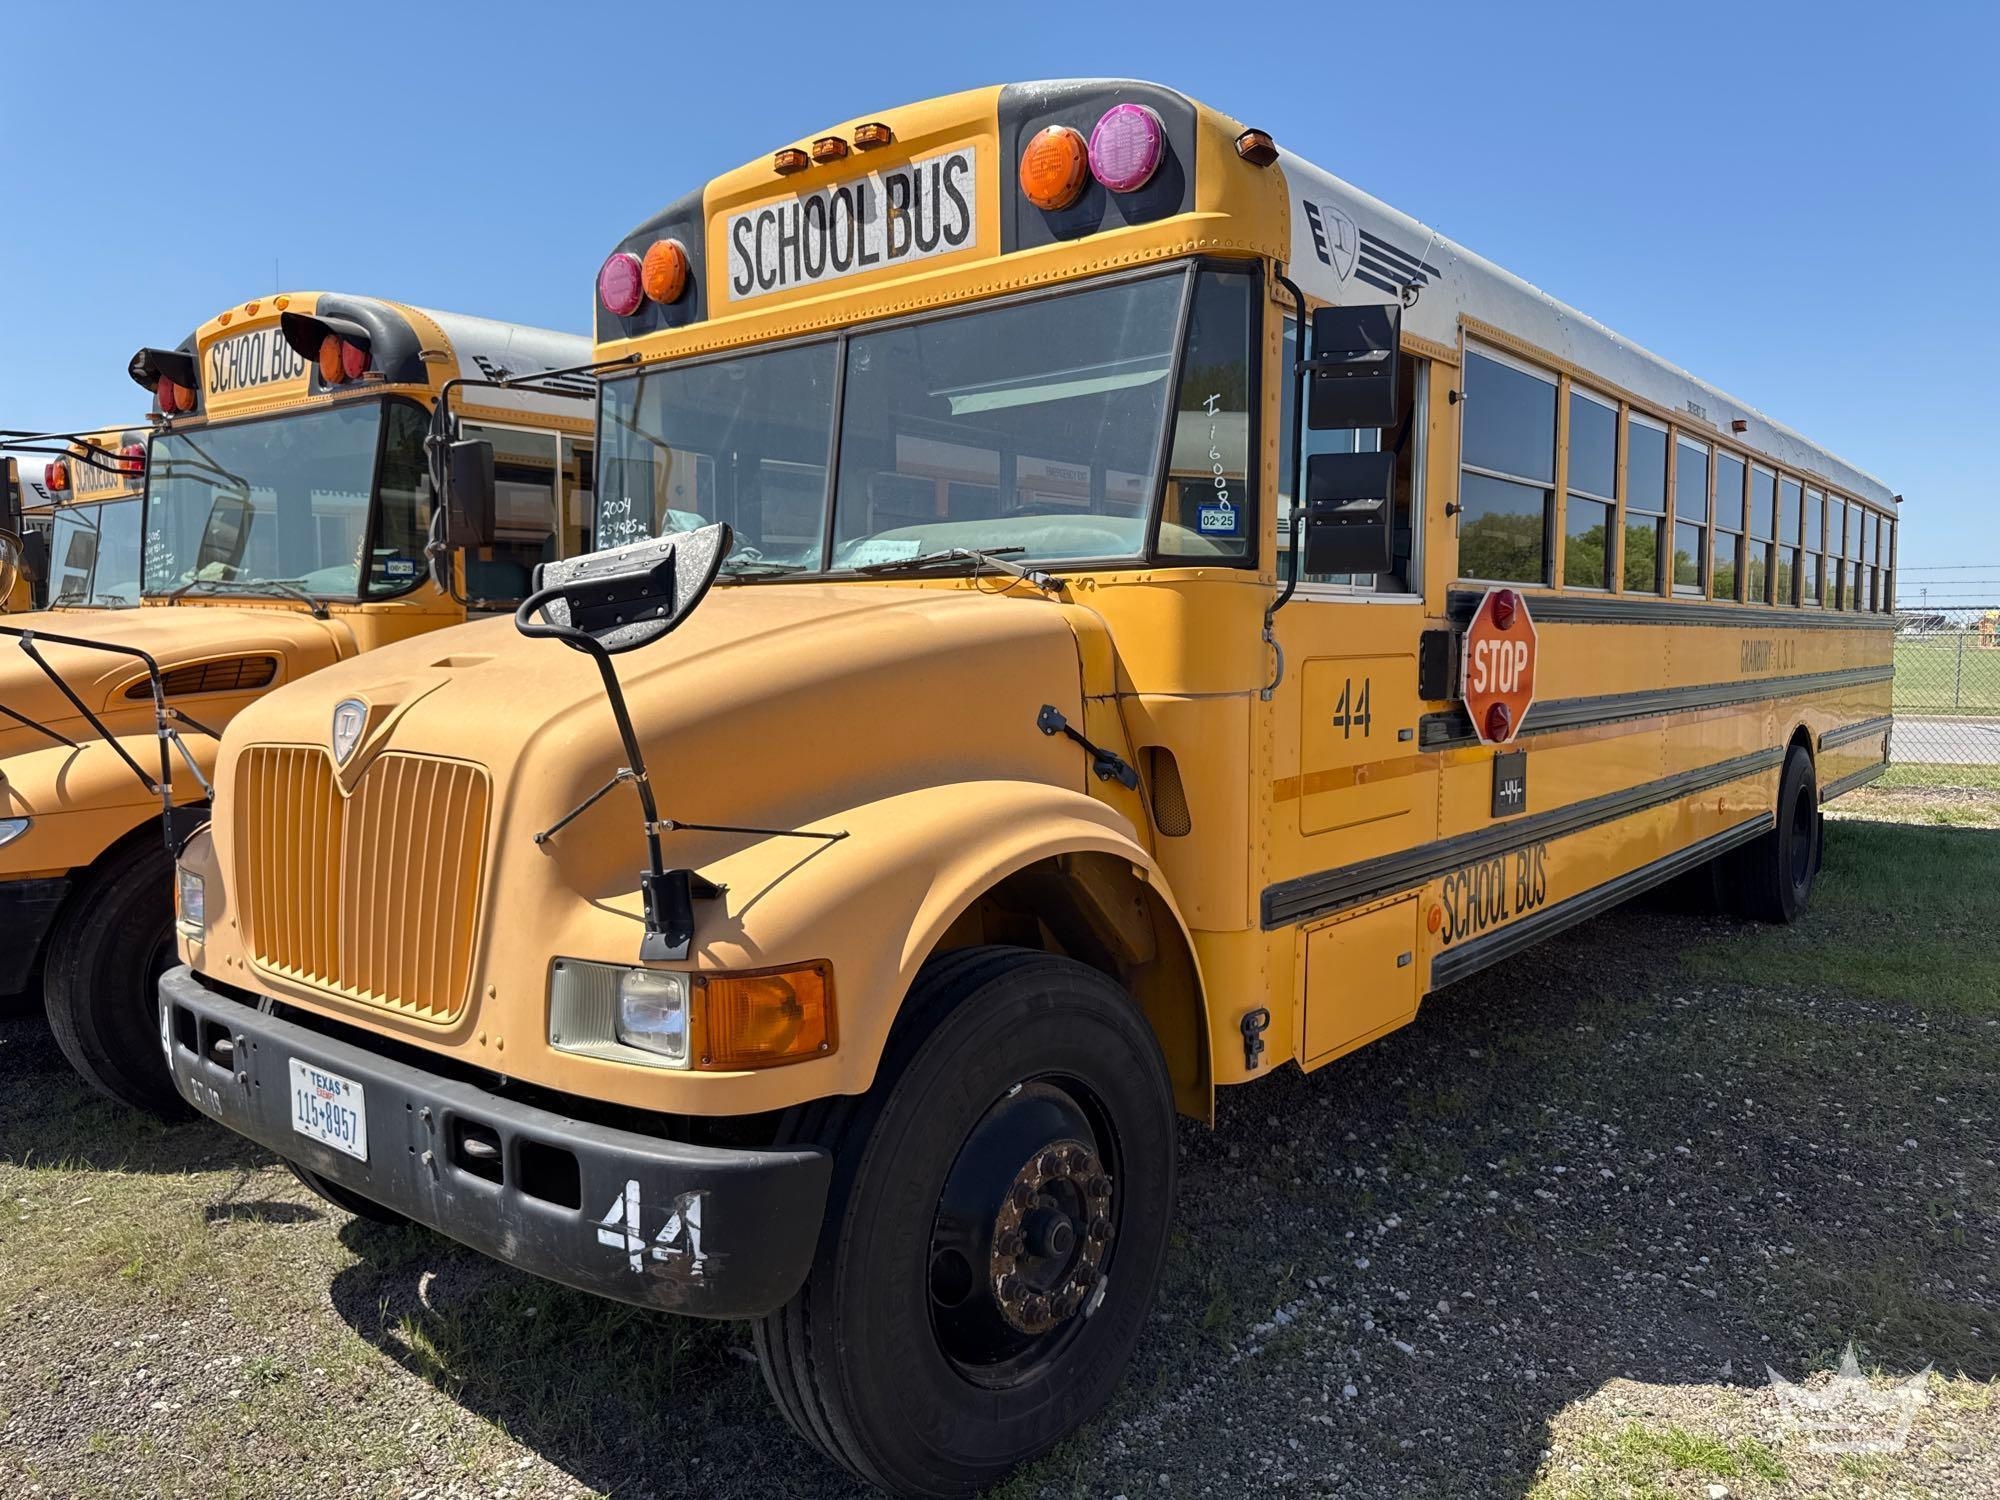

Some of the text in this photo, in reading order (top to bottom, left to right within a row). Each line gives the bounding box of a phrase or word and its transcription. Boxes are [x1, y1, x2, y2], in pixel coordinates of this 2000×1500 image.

[733, 155, 970, 295] SCHOOL BUS
[211, 332, 269, 394] SCHOOL
[602, 497, 631, 519] 2004
[1473, 639, 1528, 694] STOP
[1333, 678, 1371, 740] 44
[1441, 843, 1547, 946] SCHOOL BUS
[310, 1071, 341, 1096] TEXAS
[597, 1179, 708, 1287] 44
